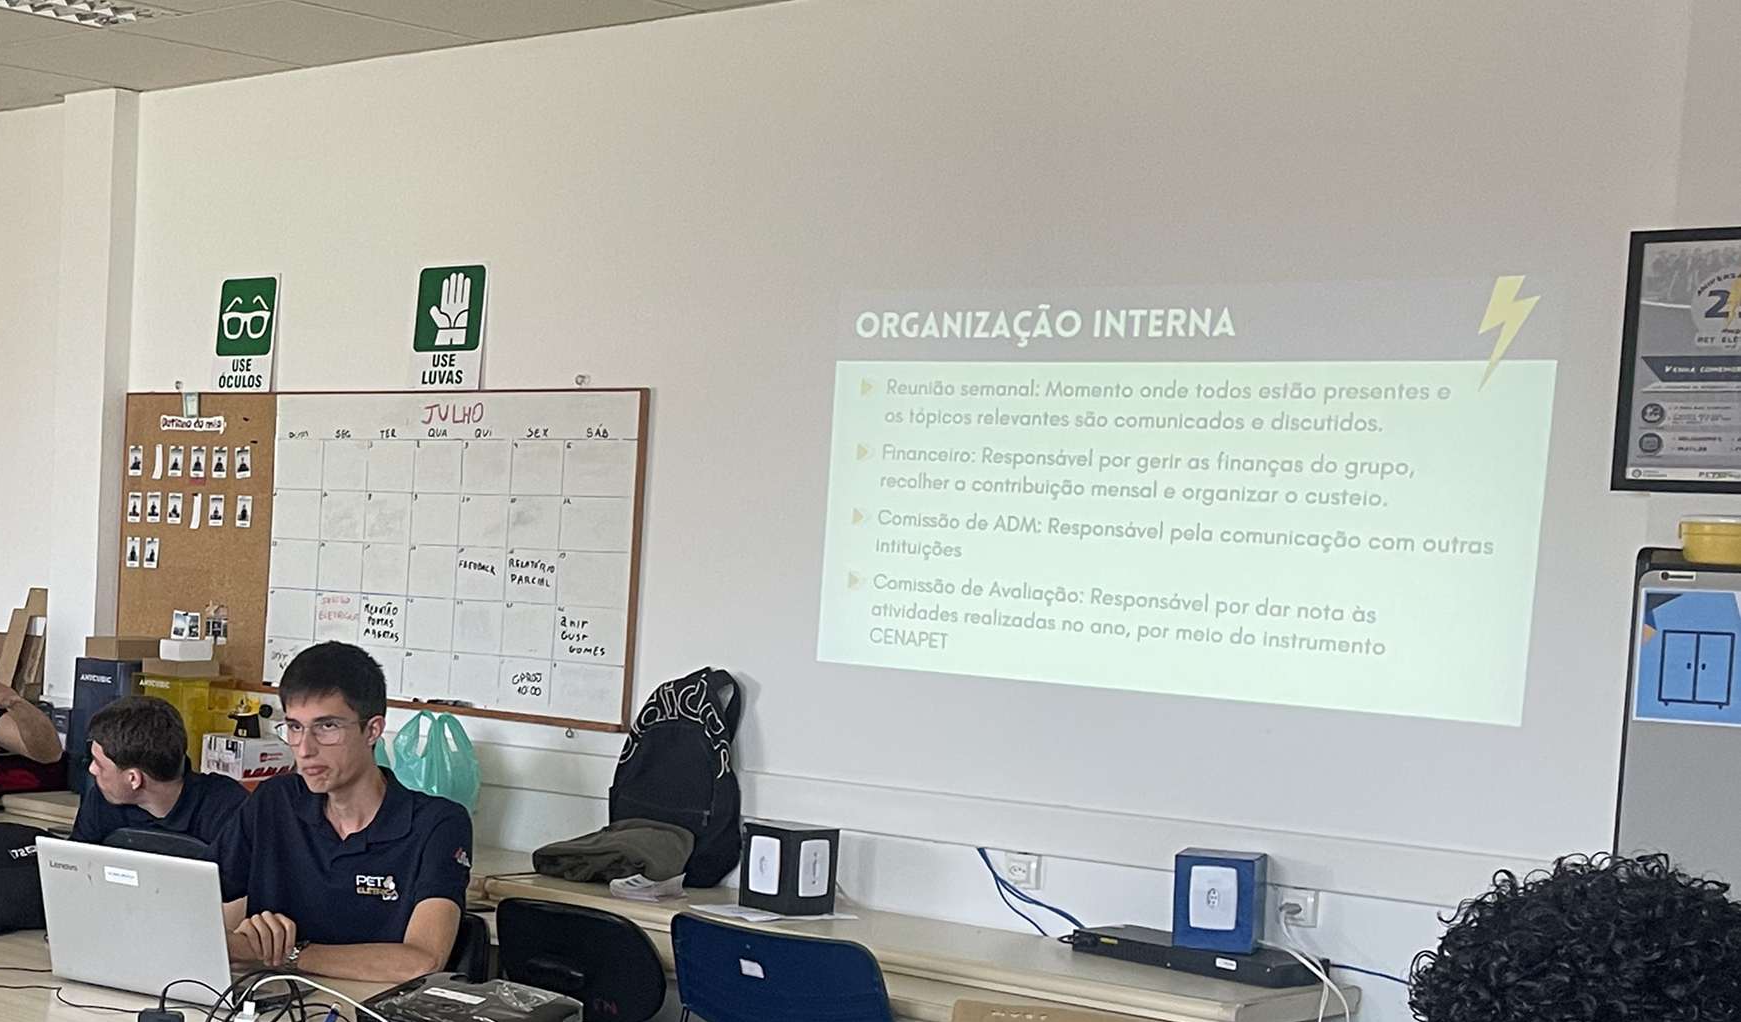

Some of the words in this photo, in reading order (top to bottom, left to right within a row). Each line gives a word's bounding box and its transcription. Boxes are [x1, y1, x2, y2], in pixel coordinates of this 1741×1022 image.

[1704, 289, 1741, 318] 2
[856, 303, 1082, 348] ORGANIZAÇÃO
[1092, 307, 1236, 338] INTERNA
[232, 358, 252, 373] USE
[432, 353, 456, 368] USE
[218, 371, 263, 389] ÓCULOS
[420, 369, 464, 386] LUVAS
[886, 379, 955, 397] Reunião
[960, 379, 1040, 398] semanal:
[1045, 381, 1133, 399] Momento
[1140, 380, 1189, 399] onde
[1196, 380, 1252, 400] todos
[1259, 382, 1316, 400] estão
[1324, 382, 1430, 405] presentes
[1437, 385, 1451, 400] e
[421, 402, 484, 425] JULHO
[884, 410, 903, 423] os
[909, 408, 972, 429] tópicos
[977, 407, 1070, 428] relevantes
[1074, 412, 1108, 428] são
[1114, 411, 1244, 430] comunicados
[1251, 416, 1264, 430] e
[1271, 412, 1384, 432] discutidos.
[335, 429, 352, 439] SEG
[379, 428, 397, 439] TER
[427, 428, 448, 439] QUA
[474, 427, 493, 439] QUI
[526, 427, 550, 438] SEX
[586, 423, 609, 439] SÁB
[882, 444, 976, 463] Financeiro:
[981, 447, 1094, 469] Responsável
[1099, 453, 1131, 472] por
[1136, 453, 1181, 474] gerir
[1187, 456, 1210, 470] as
[1217, 451, 1304, 477] finanças
[1310, 453, 1338, 473] do
[1345, 460, 1415, 481] grupo,
[880, 472, 950, 491] recolher
[955, 478, 966, 491] a
[971, 475, 1085, 501] contribuição
[1091, 480, 1157, 498] mensal
[1163, 486, 1176, 499] e
[1182, 484, 1279, 506] organizar
[1285, 489, 1298, 503] o
[1305, 489, 1388, 507] custeio.
[877, 509, 960, 530] Comissão
[965, 512, 988, 531] de
[993, 515, 1042, 534] ADM:
[1047, 517, 1164, 541] Responsável
[1170, 522, 1213, 545] pela
[1220, 530, 1361, 553] comunicação
[1368, 536, 1415, 551] com
[1422, 535, 1495, 555] outras
[873, 573, 955, 595] Comissão
[961, 577, 984, 596] de
[988, 581, 1084, 606] Avaliação:
[1090, 587, 1209, 612] Responsável
[1215, 599, 1250, 618] por
[1255, 597, 1291, 617] dar
[1297, 603, 1345, 621] nota
[1352, 605, 1377, 624] às
[869, 627, 949, 650] CENAPET
[871, 602, 958, 623] atividades
[964, 609, 1056, 631] realizadas
[1062, 618, 1084, 632] no
[1090, 621, 1131, 639] ano,
[1137, 624, 1169, 642] por
[1176, 627, 1223, 643] meio
[1229, 626, 1256, 645] do
[1263, 631, 1386, 656] instrumento
[49, 860, 78, 872] Lenovo
[356, 875, 384, 887] PET
